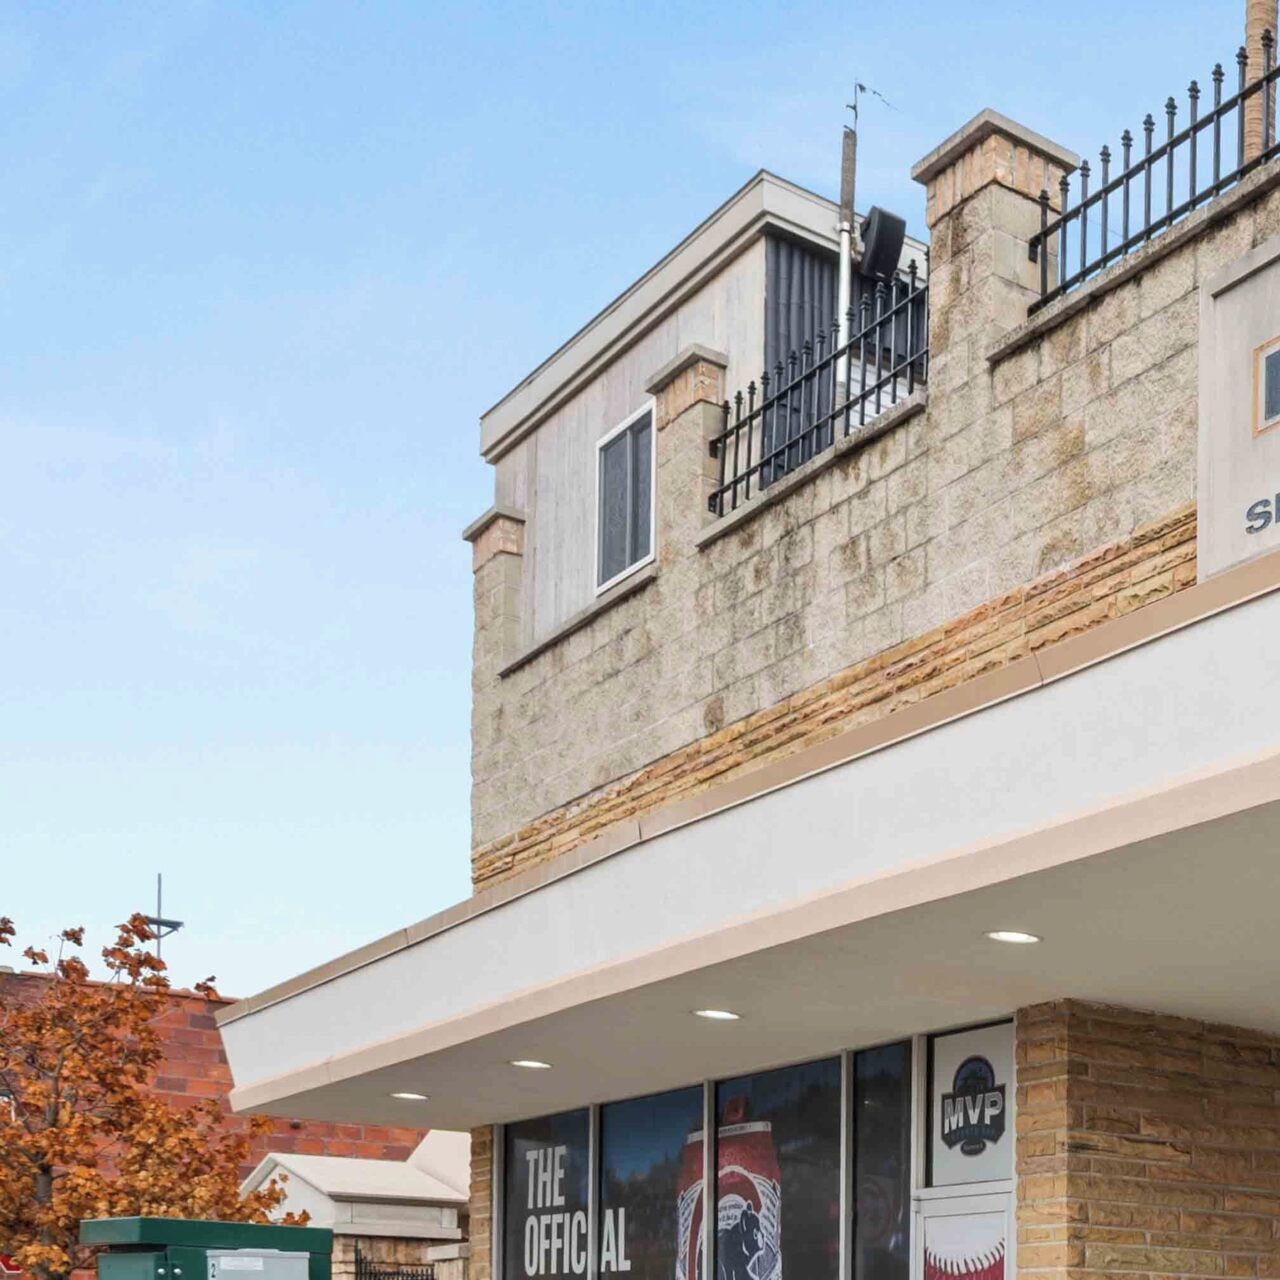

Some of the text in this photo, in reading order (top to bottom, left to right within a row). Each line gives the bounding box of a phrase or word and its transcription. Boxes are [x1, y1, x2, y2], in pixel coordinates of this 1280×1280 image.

[943, 1091, 1003, 1134] MVP
[526, 1145, 567, 1209] THE
[524, 1207, 631, 1276] OFFICAL
